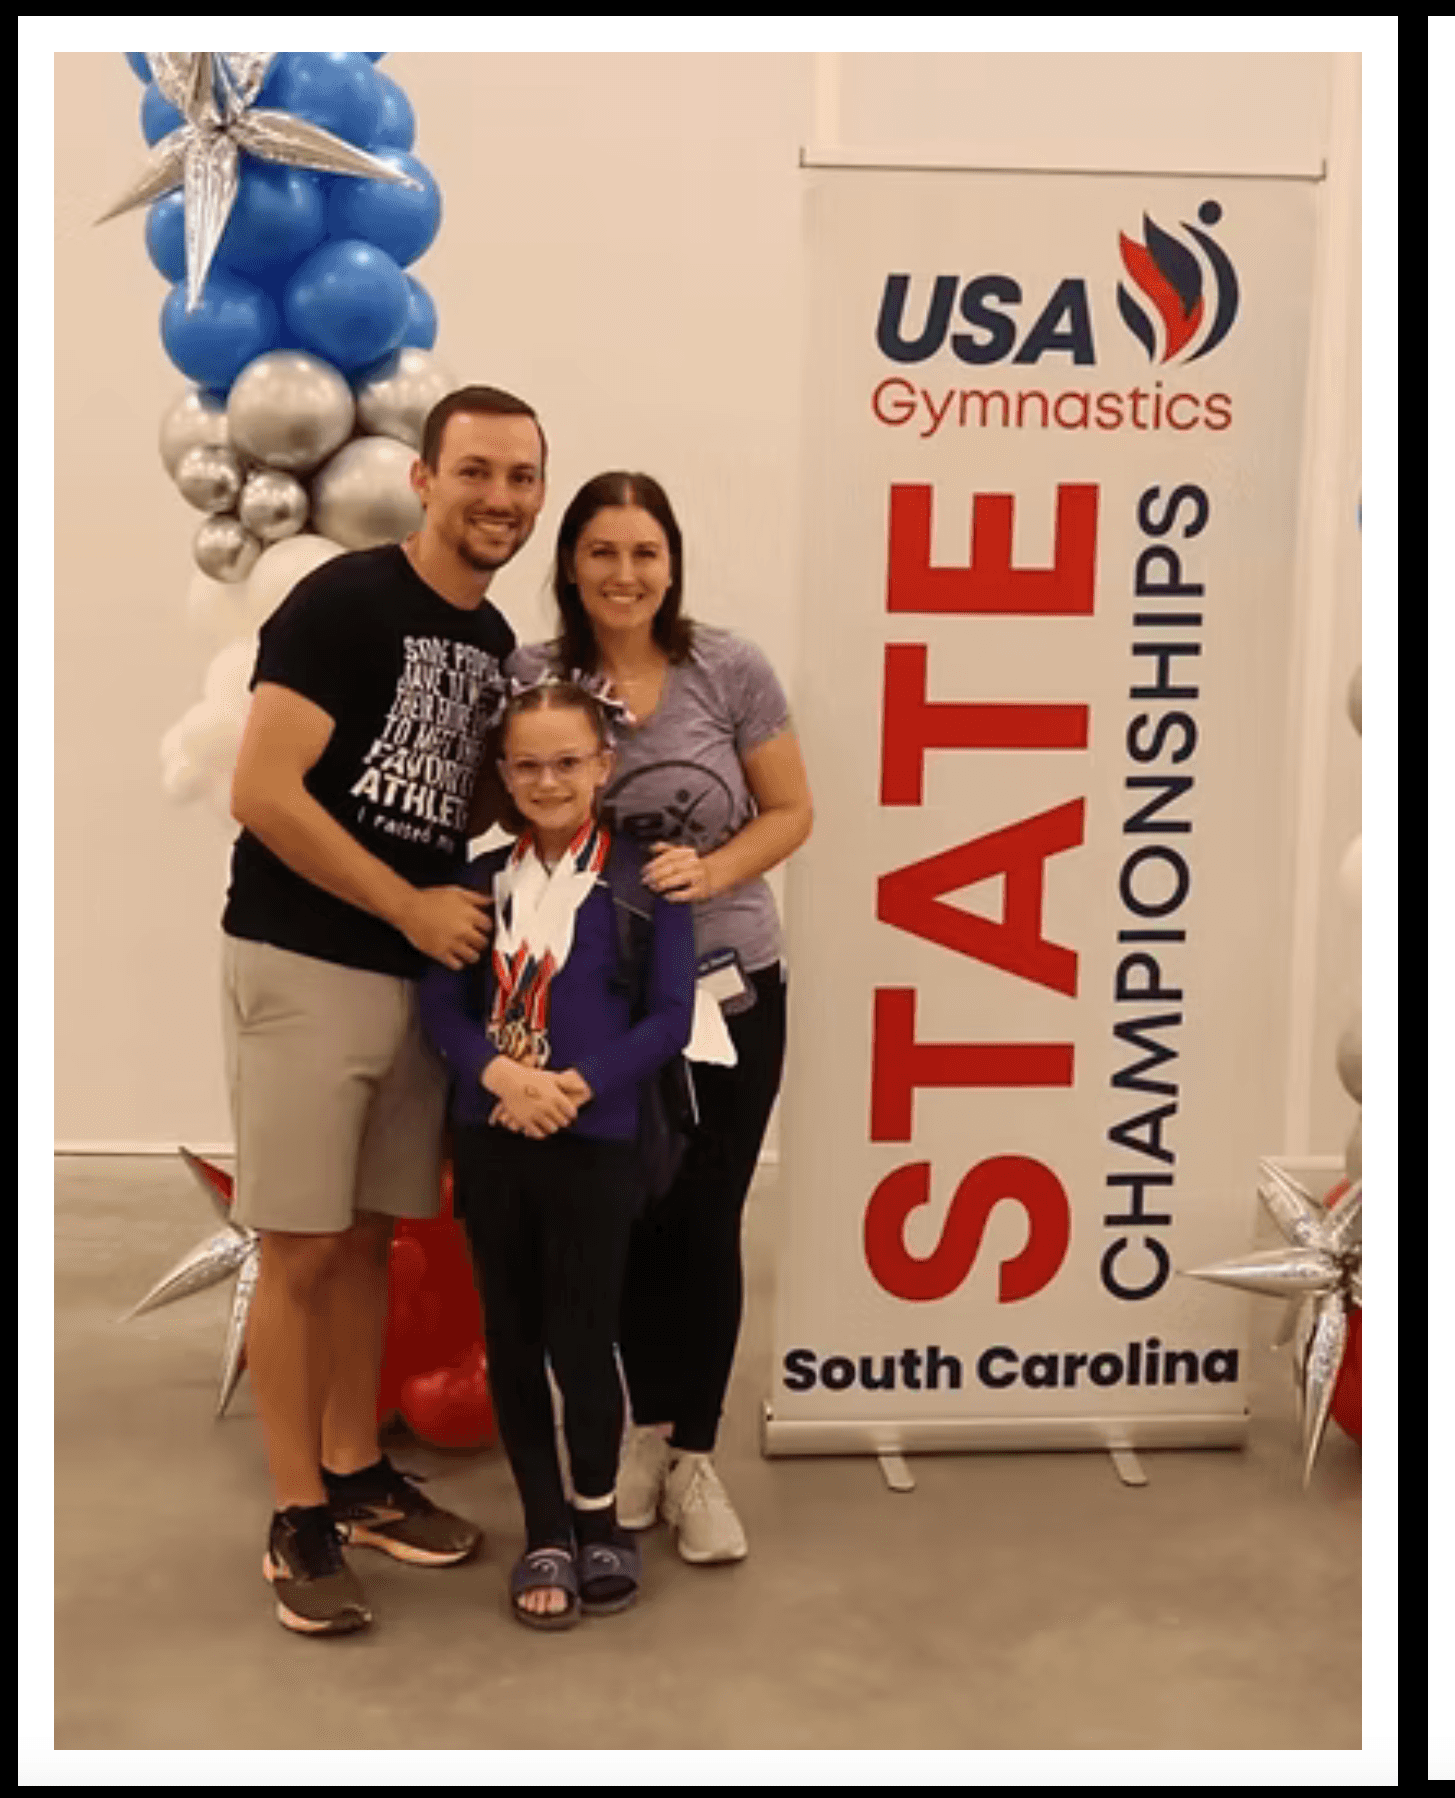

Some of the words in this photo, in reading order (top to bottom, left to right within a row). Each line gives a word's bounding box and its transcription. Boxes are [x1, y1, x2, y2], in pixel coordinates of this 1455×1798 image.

[876, 274, 1097, 365] USA
[871, 377, 1233, 438] Gymnastics
[382, 713, 412, 744] TO
[864, 482, 1100, 1304] STATE
[1100, 484, 1210, 1302] CHAMPIONSHIPS
[783, 1346, 963, 1391] South
[976, 1338, 1240, 1389] Carolina
